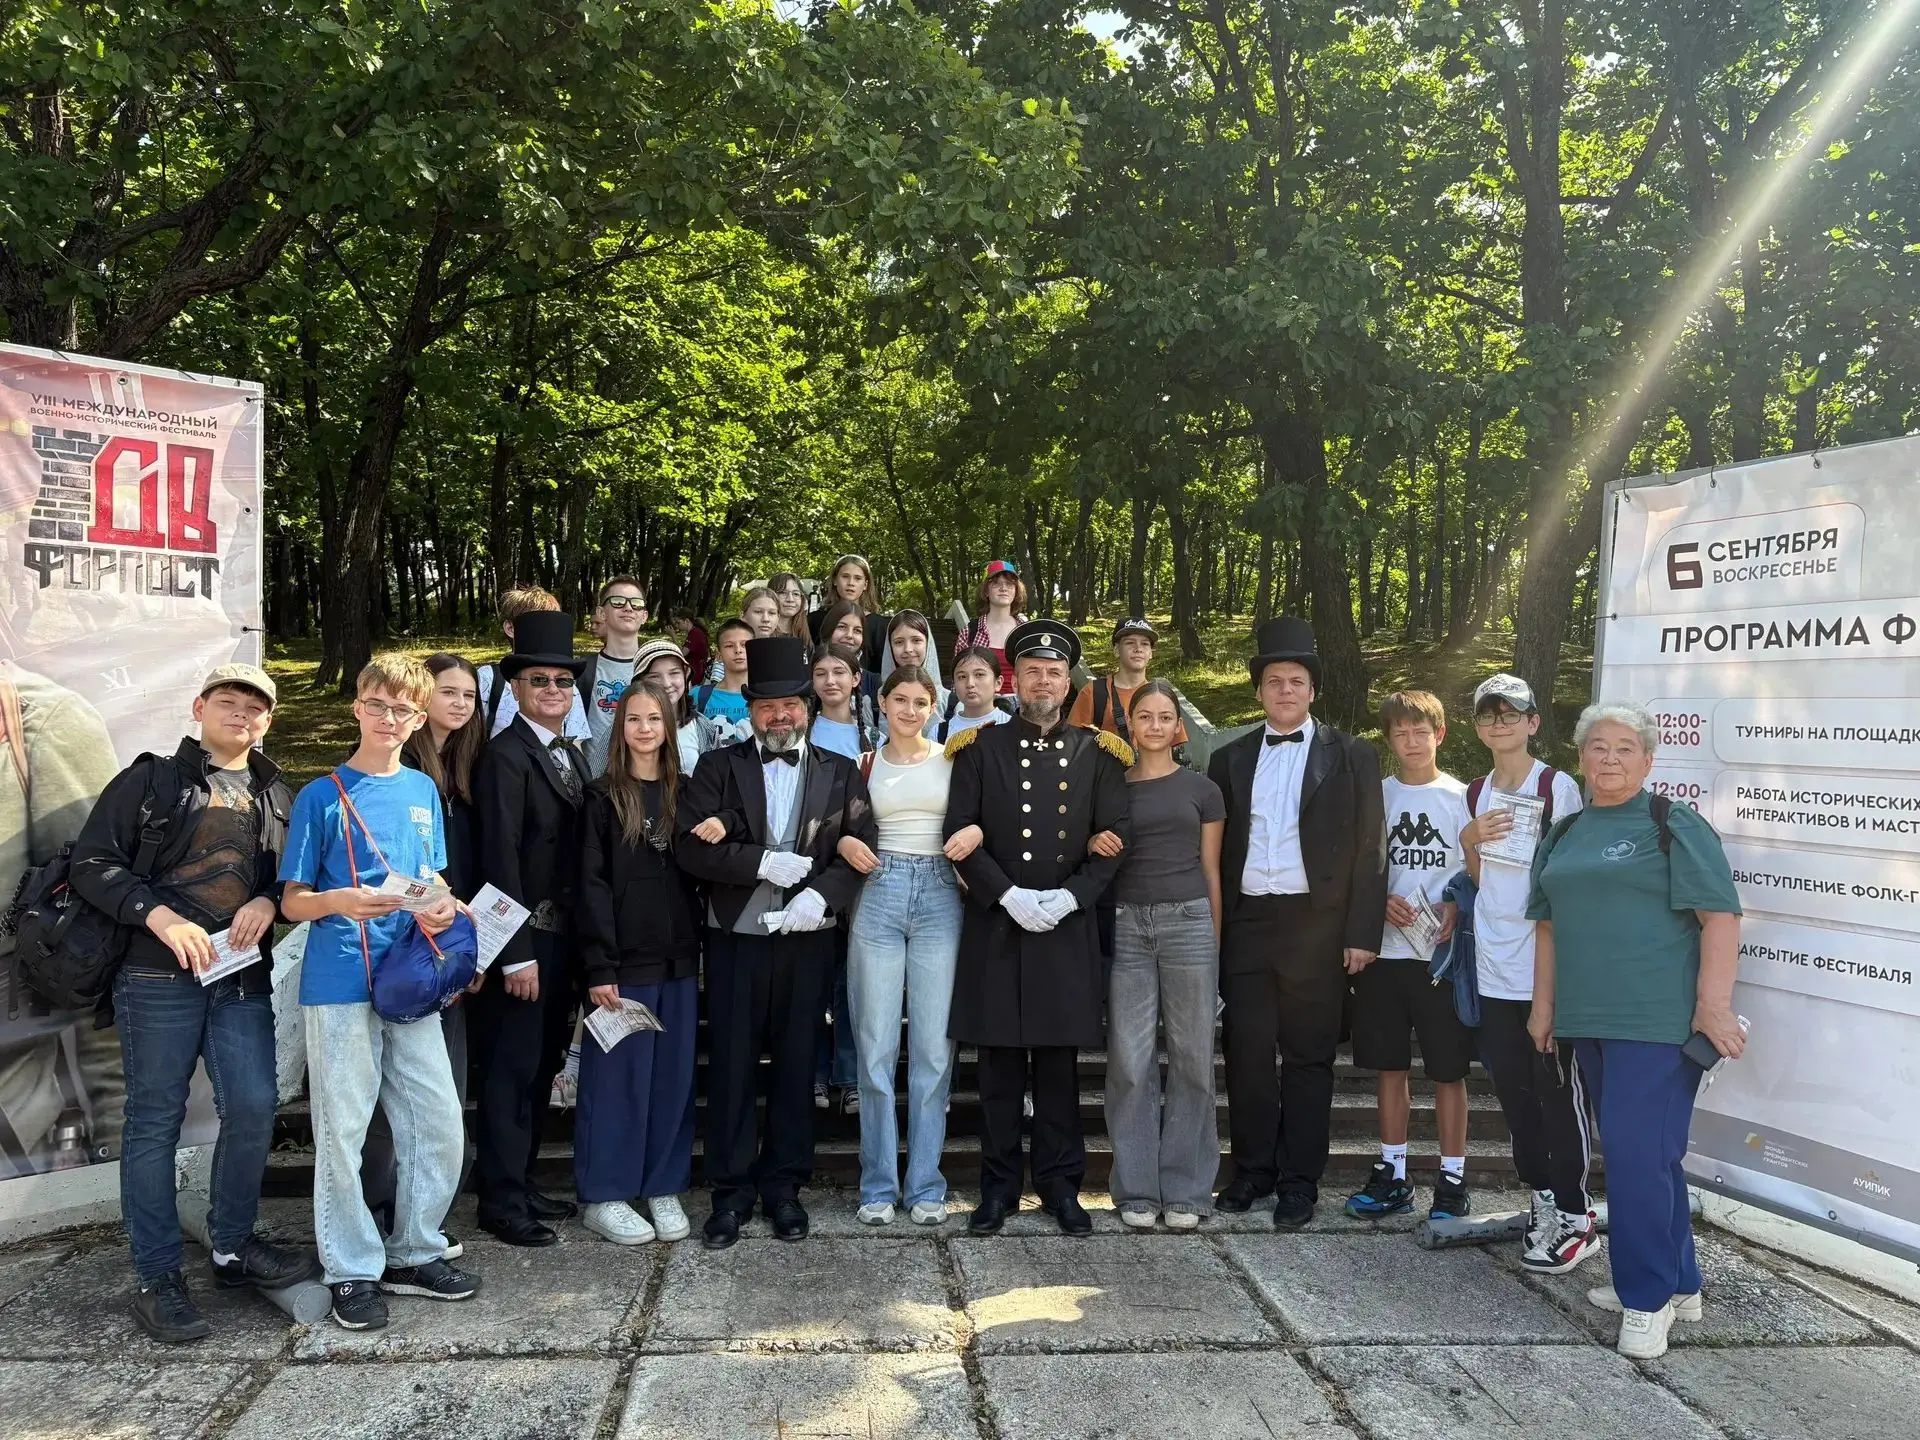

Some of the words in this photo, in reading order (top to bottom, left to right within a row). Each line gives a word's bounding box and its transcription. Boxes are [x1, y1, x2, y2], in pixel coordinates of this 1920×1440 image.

[30, 407, 158, 431] ВОЕННО-ИСТОРИЧЕСКИЙ
[160, 425, 217, 439] ФЕСТИВАЛЬ
[31, 393, 57, 407] VIII
[61, 398, 218, 430] МЕЖДУНАРОДНЫЙ
[1708, 528, 1838, 562] СЕНТЯБРЯ
[24, 542, 220, 600] ФОРПОСТ
[1713, 557, 1837, 584] ВОСКРЕСЕНЬЕ
[1660, 616, 1870, 653] ПРОГРАММА
[1882, 613, 1917, 645] Ф
[1655, 713, 1707, 729] 12:00-
[1736, 725, 1803, 739] ТУРНИРЫ
[1808, 726, 1829, 740] НА
[1833, 727, 1920, 744] ПЛОЩАДК
[1657, 731, 1700, 746] 16:00
[1737, 787, 1787, 802] РАБОТА
[1790, 790, 1920, 811] ИСТОРИЧЕСКИХ
[1736, 807, 1850, 829] ИНТЕРАКТИВОВ
[1855, 816, 1867, 830] И
[1872, 818, 1920, 834] МАСТ
[1732, 869, 1846, 895] ВЫСТУПЛЕНИЕ
[1851, 884, 1919, 903] ФОЛК-Г
[1738, 943, 1809, 966] АКРЫТИЕ
[1813, 955, 1912, 985] ФЕСТИВАЛЯ
[1852, 1177, 1891, 1198] АУИПИК
